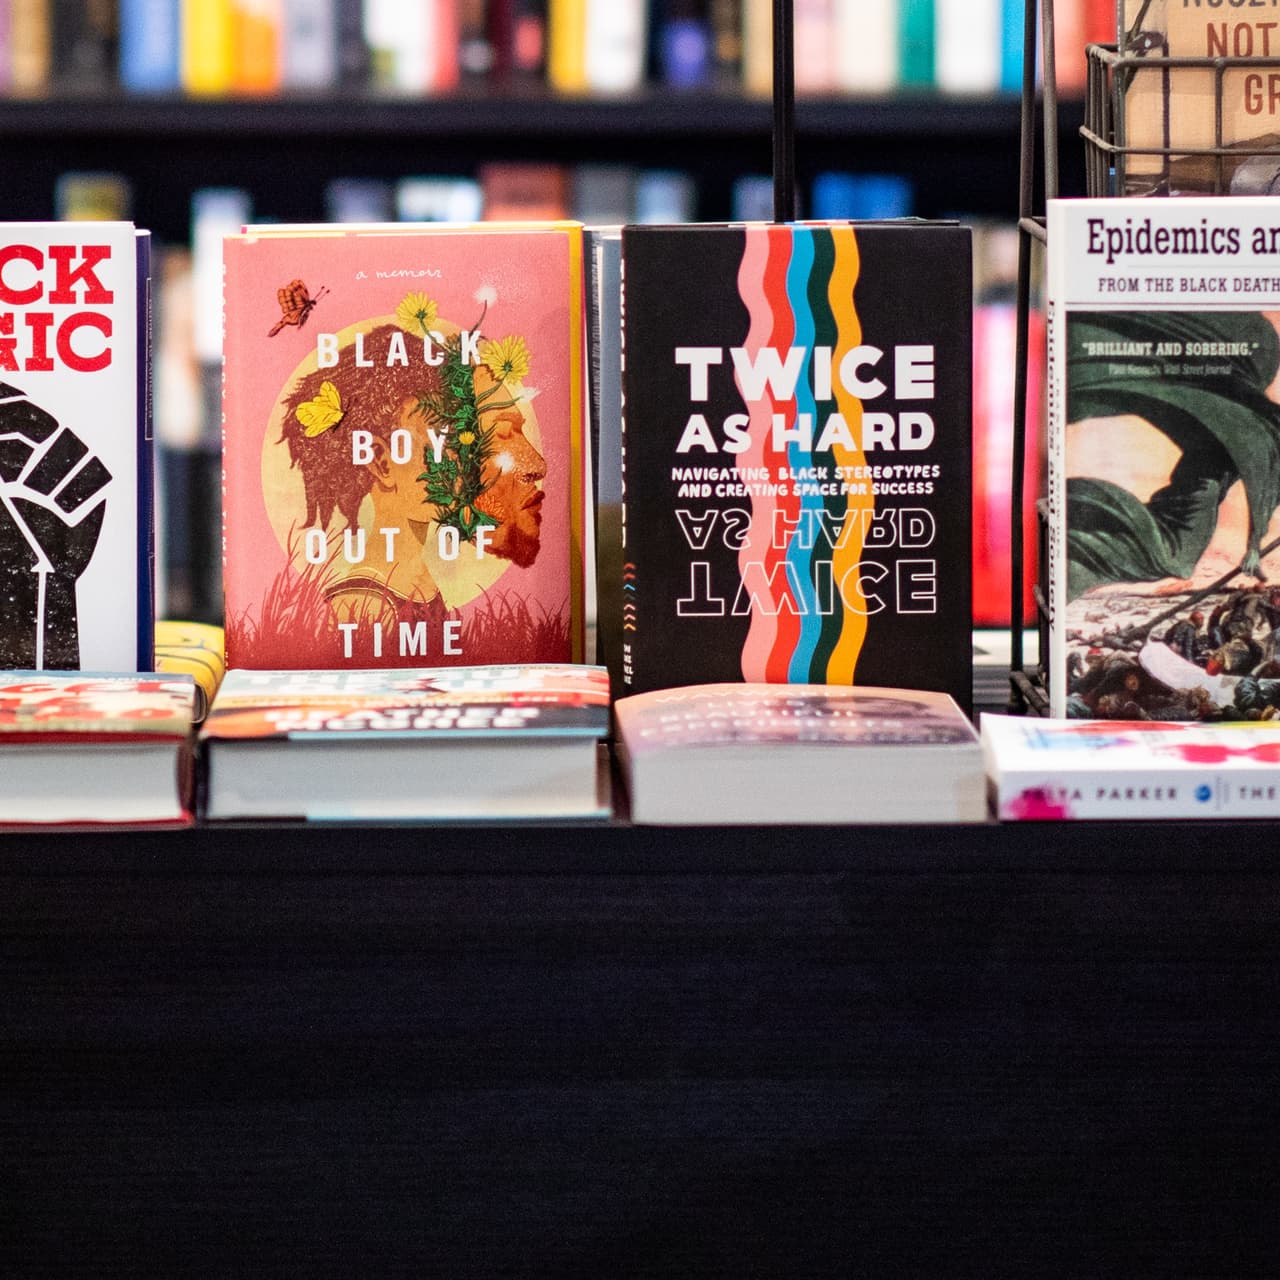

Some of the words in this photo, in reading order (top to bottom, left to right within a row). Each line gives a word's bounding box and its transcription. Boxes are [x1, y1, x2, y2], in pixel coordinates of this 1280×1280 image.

[1087, 219, 1240, 264] Epidemics
[376, 266, 443, 280] memoir
[1098, 278, 1140, 292] FROM
[1145, 278, 1174, 292] THE
[1180, 278, 1227, 292] BLACK
[1233, 278, 1280, 292] DEATH
[317, 330, 482, 368] BLACK
[1156, 342, 1182, 356] AND
[675, 345, 935, 401] TWICE
[352, 425, 449, 466] BOY
[676, 414, 752, 454] AS
[772, 412, 935, 453] HARD
[672, 467, 770, 481] NAVIGATING
[778, 466, 828, 480] BLACK
[834, 465, 940, 479] STEREOTYPES
[678, 483, 713, 498] AND
[715, 482, 789, 498] CREATING
[792, 482, 838, 497] SPACE
[840, 481, 868, 496] FOR
[871, 480, 934, 495] SUCCESS
[305, 526, 401, 564] OUT
[438, 525, 498, 561] OF
[338, 620, 464, 658] TIME
[1096, 786, 1178, 800] PARKER
[1239, 786, 1277, 800] THE
